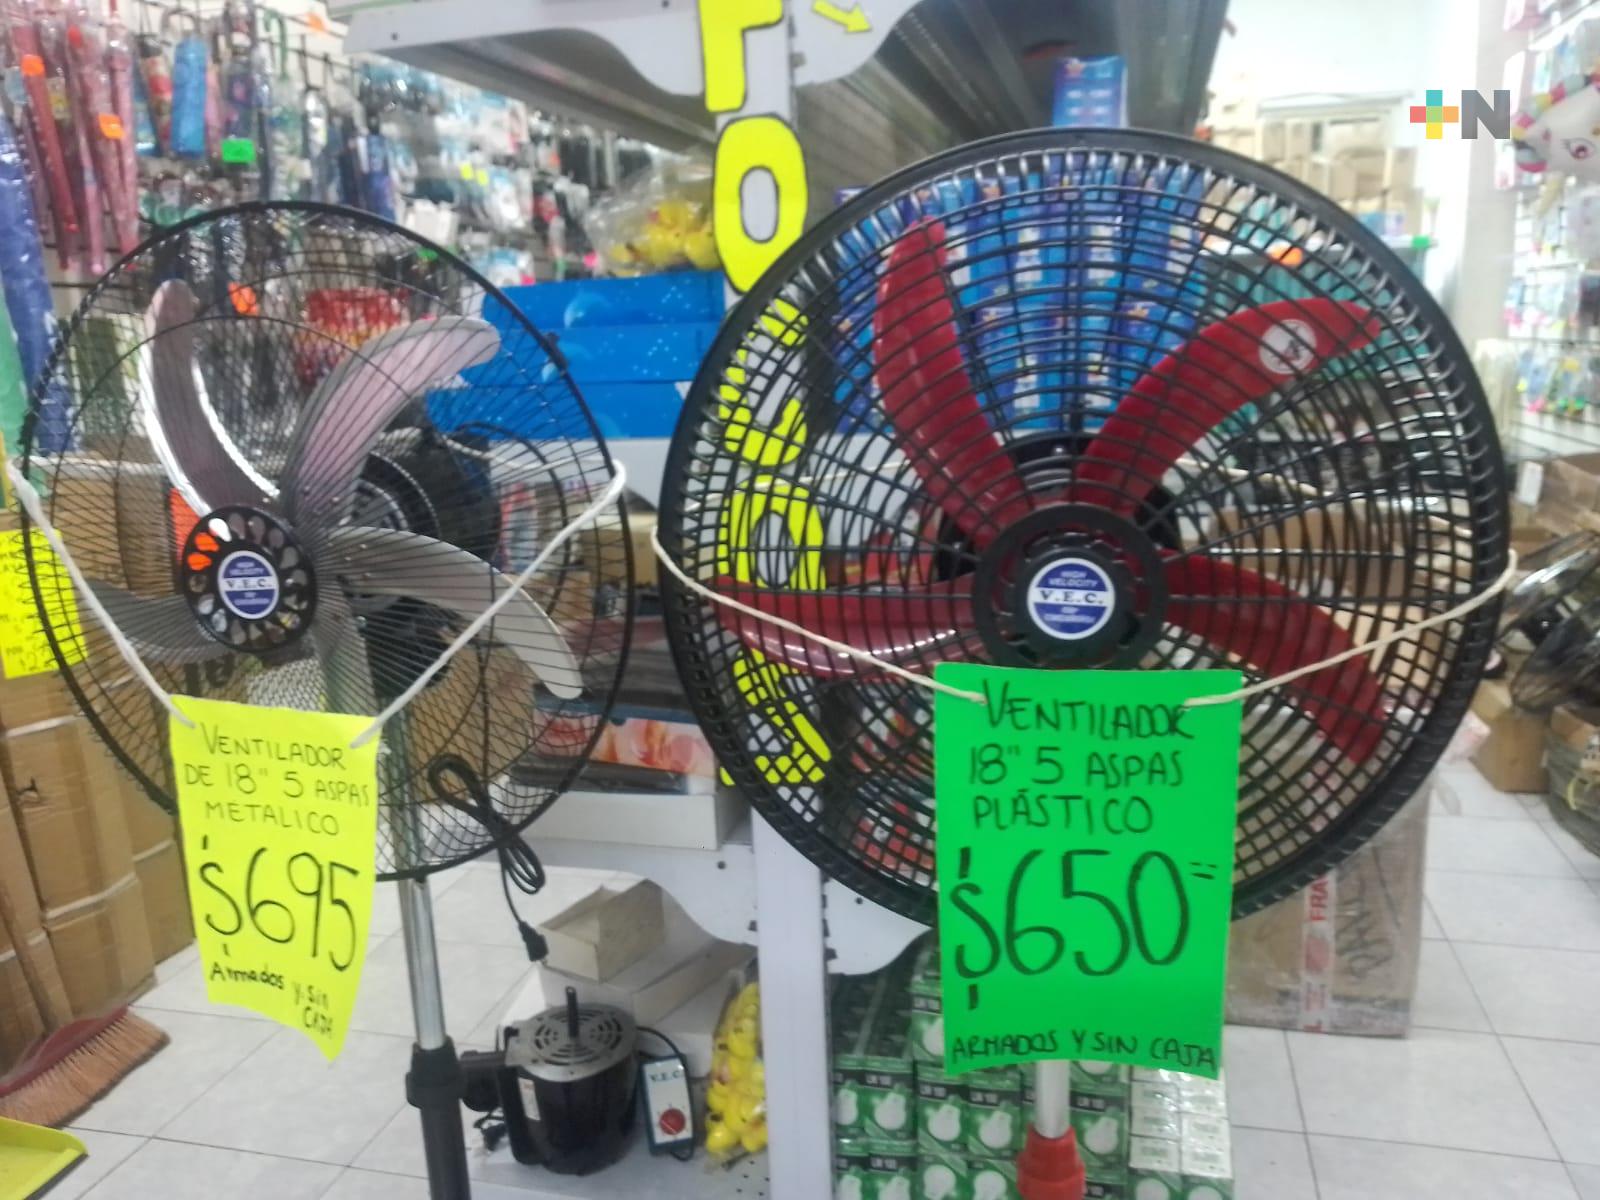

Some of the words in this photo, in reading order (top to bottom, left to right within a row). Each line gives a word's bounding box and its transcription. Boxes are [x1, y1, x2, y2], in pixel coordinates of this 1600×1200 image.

[1040, 589, 1104, 604] V.E.C.
[983, 678, 1195, 741] VENTILADOR
[201, 722, 347, 771] VENTILADOR
[1031, 745, 1064, 785] 5
[1085, 750, 1184, 789] ASPAS
[184, 763, 214, 787] DE
[283, 770, 304, 798] 5
[314, 779, 370, 808] ASPAS
[205, 800, 339, 836] METALICO
[973, 787, 1153, 835] PLÁSTICO
[199, 834, 360, 972] $695
[1308, 874, 1330, 922] FRA
[951, 1030, 1058, 1063] ARMADOS
[1071, 1029, 1087, 1054] Y
[1093, 1032, 1138, 1055] SIN
[1151, 1037, 1217, 1071] CAJA
